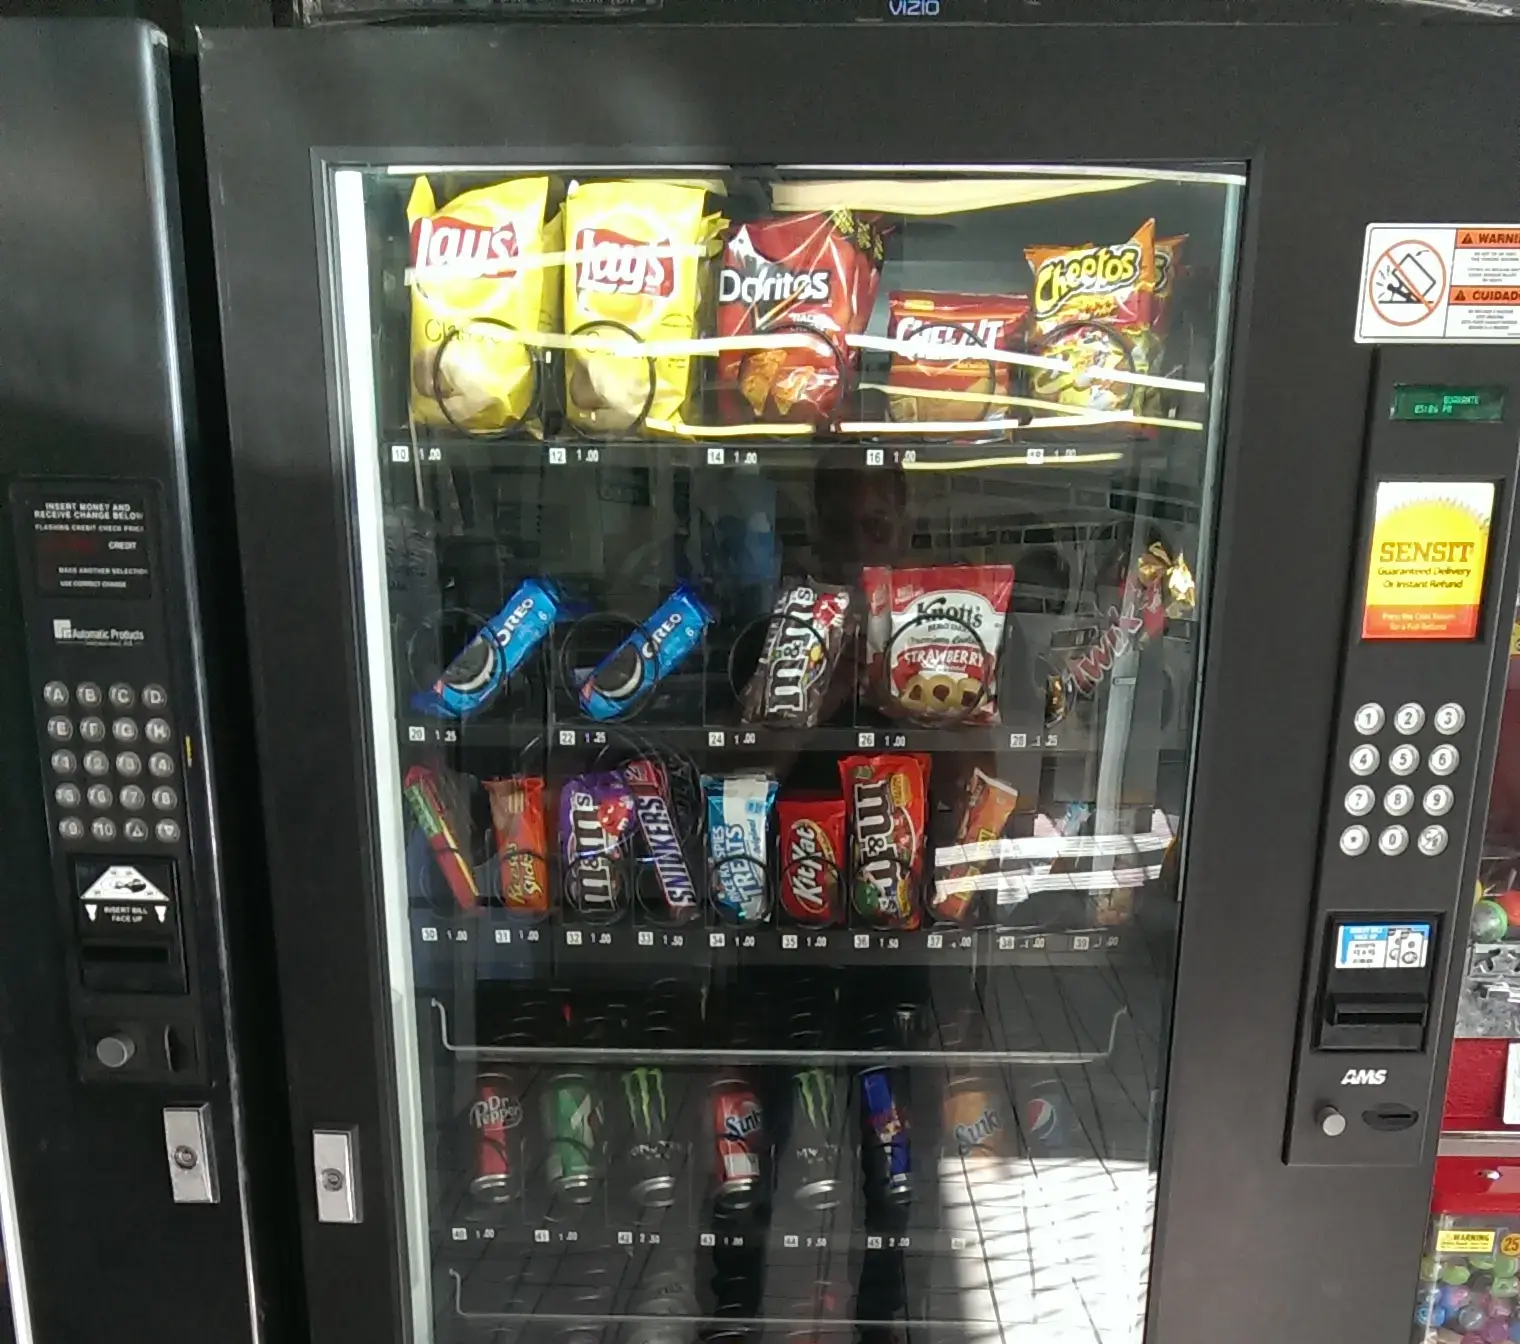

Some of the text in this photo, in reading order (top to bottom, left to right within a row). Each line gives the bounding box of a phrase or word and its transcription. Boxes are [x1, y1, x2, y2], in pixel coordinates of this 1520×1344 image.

[889, 0, 940, 15] VIZIO
[1478, 233, 1520, 244] WARNI
[719, 269, 829, 303] Doritos
[1034, 248, 1138, 316] Cheetos
[1472, 290, 1520, 301] CUIDAD
[1380, 542, 1475, 562] SENSIT
[915, 597, 983, 628] Knott's
[496, 598, 534, 648] OREO
[73, 629, 144, 640] Automatic Products
[641, 612, 682, 659] OREO
[903, 650, 985, 668] STRAWBERRY
[53, 689, 64, 701] A
[85, 689, 97, 702] B
[117, 689, 129, 703] C
[151, 690, 162, 704] D
[639, 796, 697, 906] SNICKERS
[725, 823, 764, 902] TREATS
[1340, 1069, 1387, 1085] AMS
[1453, 1233, 1490, 1242] WARNING
[1503, 1237, 1519, 1252] 25
